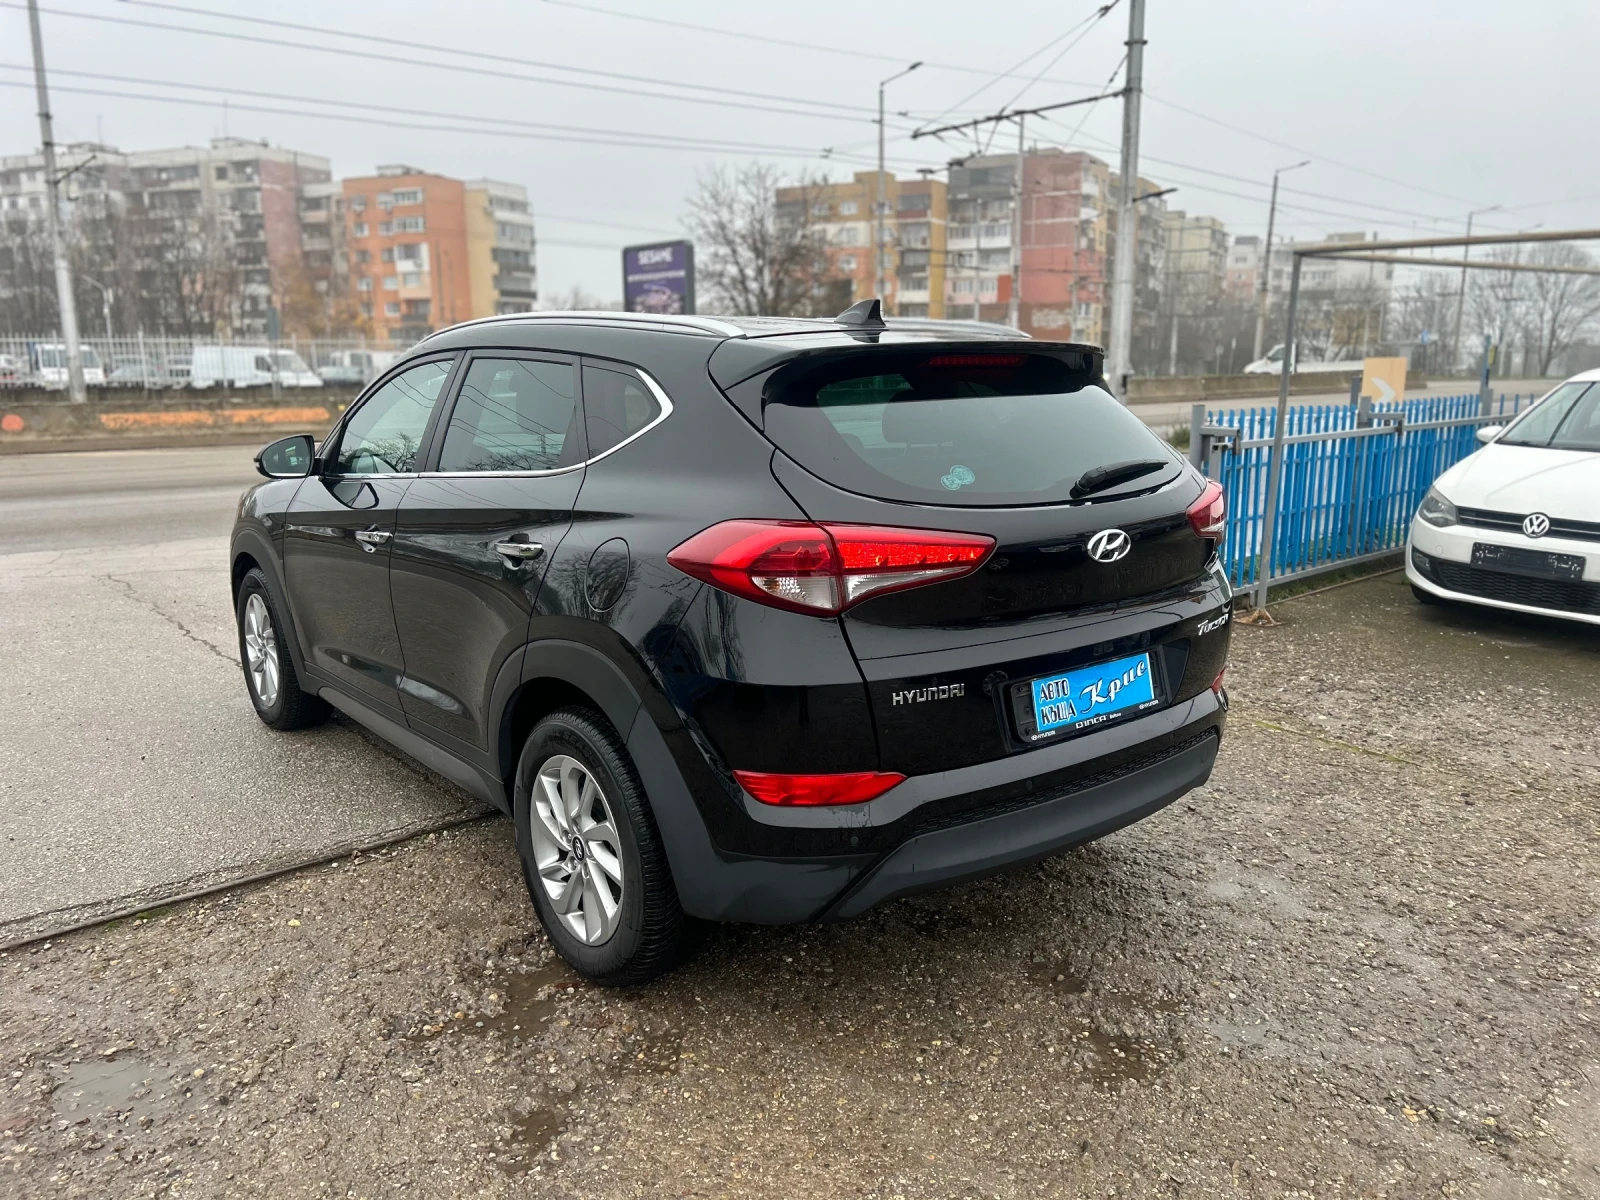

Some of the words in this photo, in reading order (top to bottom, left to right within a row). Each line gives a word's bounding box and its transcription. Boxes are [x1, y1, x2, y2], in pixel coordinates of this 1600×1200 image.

[892, 682, 965, 706] HYUNDAI
[1038, 677, 1070, 704] АВТО
[1078, 659, 1148, 714] Крис
[1040, 699, 1077, 726] КЪЩА
